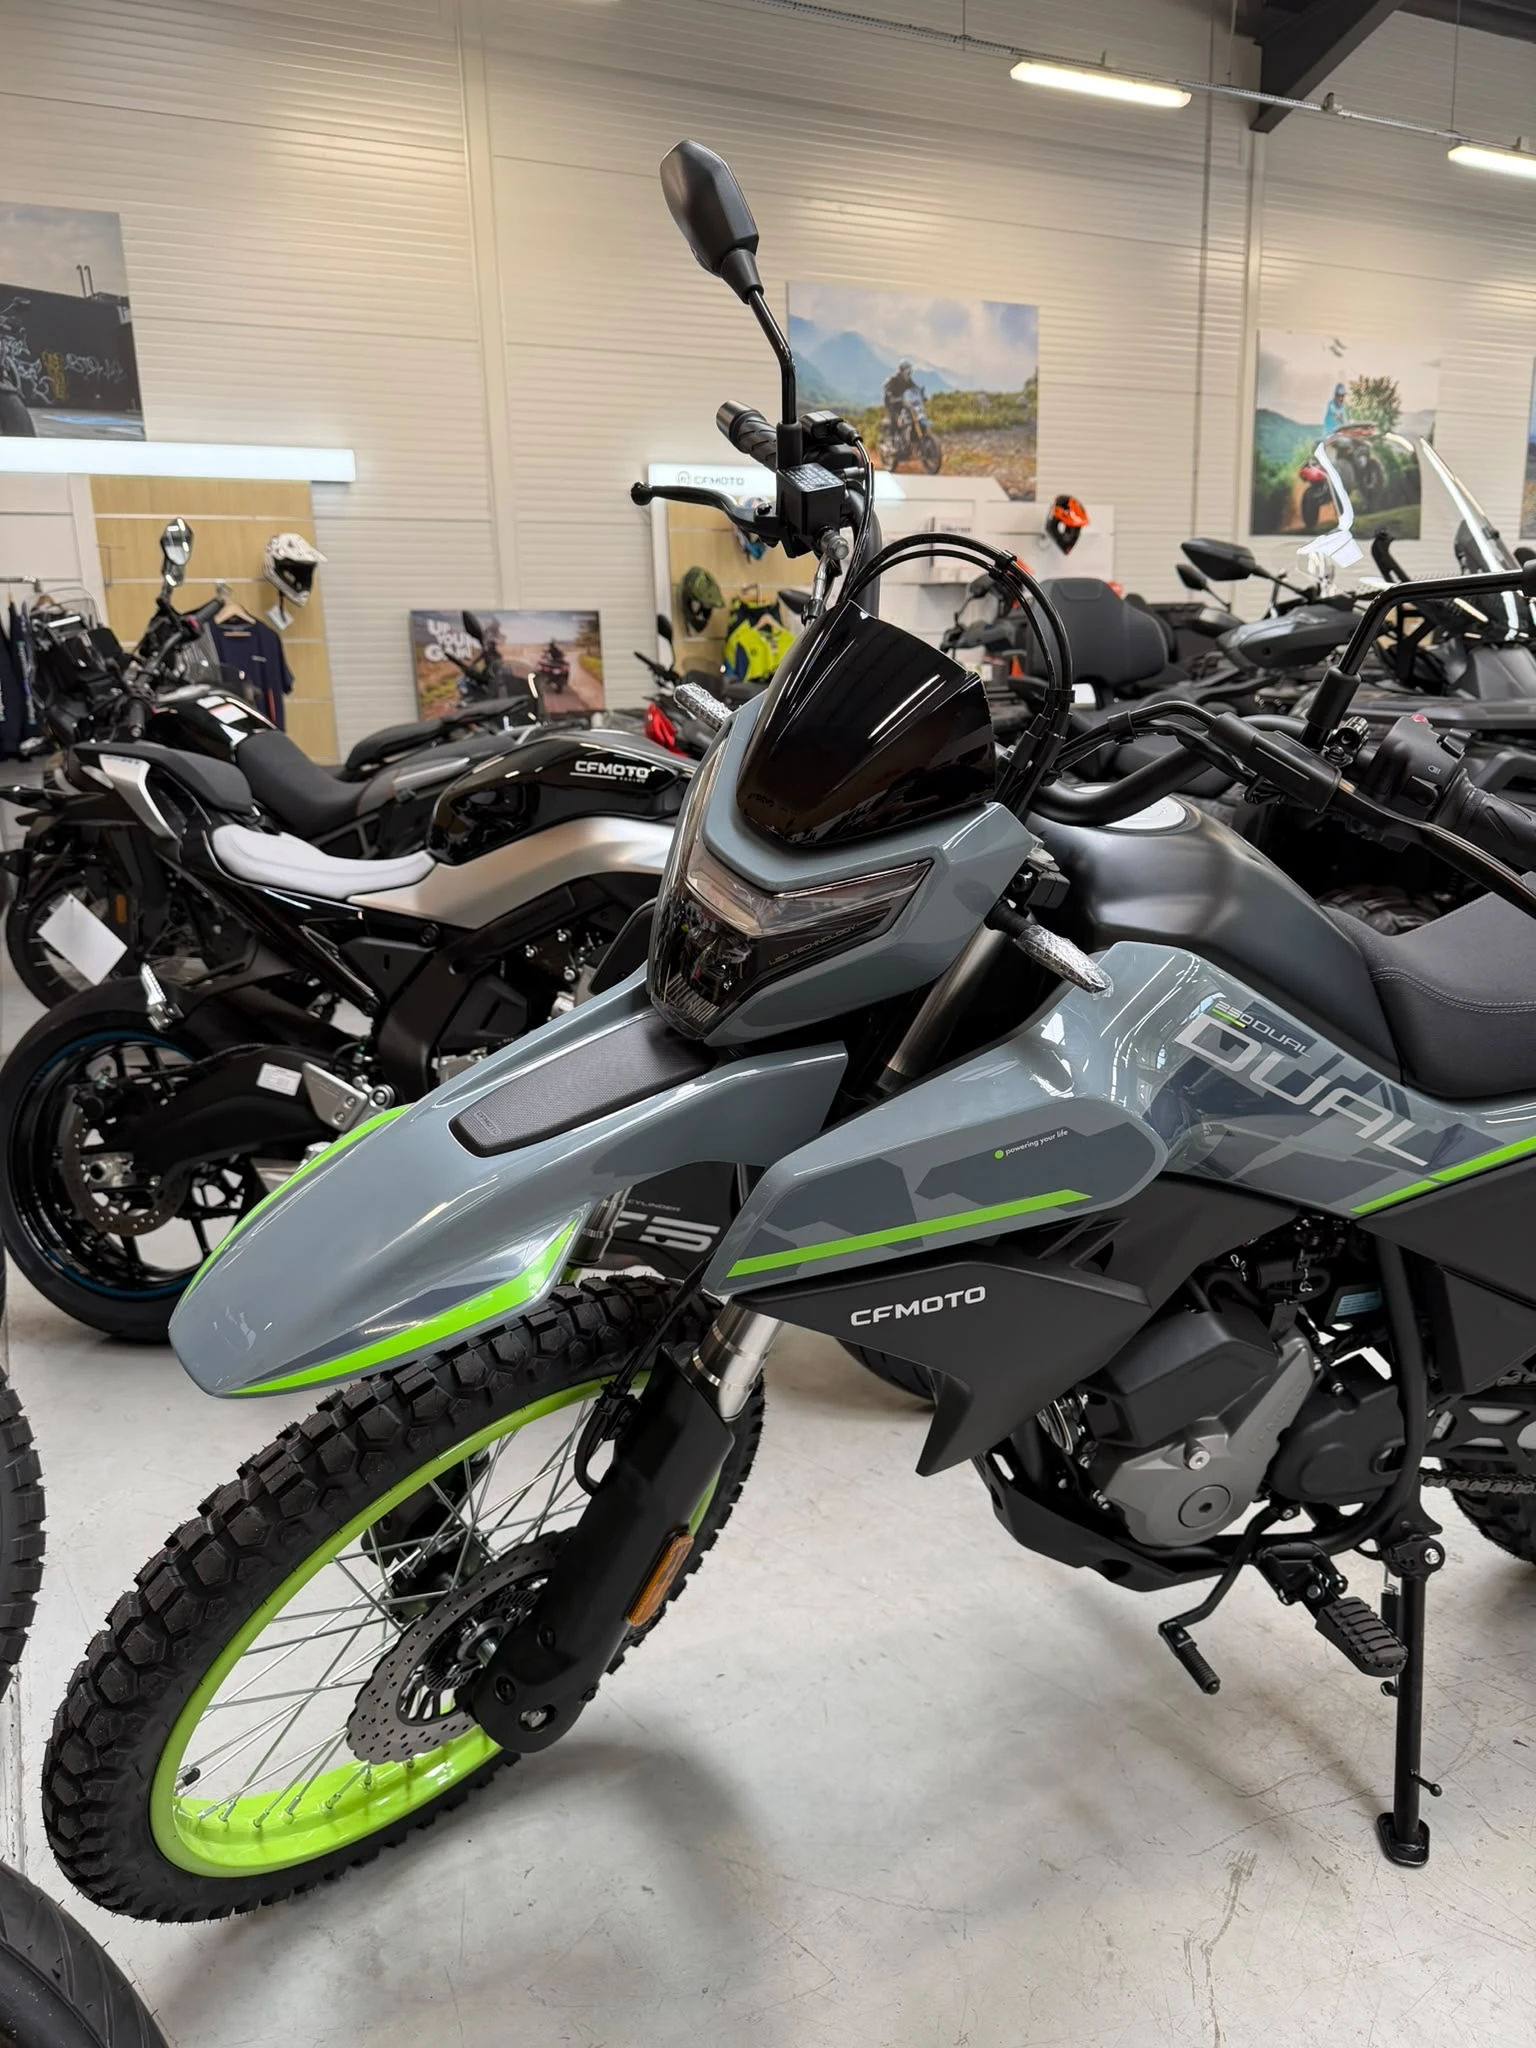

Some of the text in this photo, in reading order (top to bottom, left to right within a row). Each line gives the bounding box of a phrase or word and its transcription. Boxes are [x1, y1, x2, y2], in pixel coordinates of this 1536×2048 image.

[574, 760, 651, 779] CFMOTO
[1215, 1000, 1311, 1058] 250 DUAL
[1173, 1014, 1429, 1167] DUAL
[1005, 1129, 1068, 1156] powering your life
[851, 1286, 986, 1326] CFMOTO
